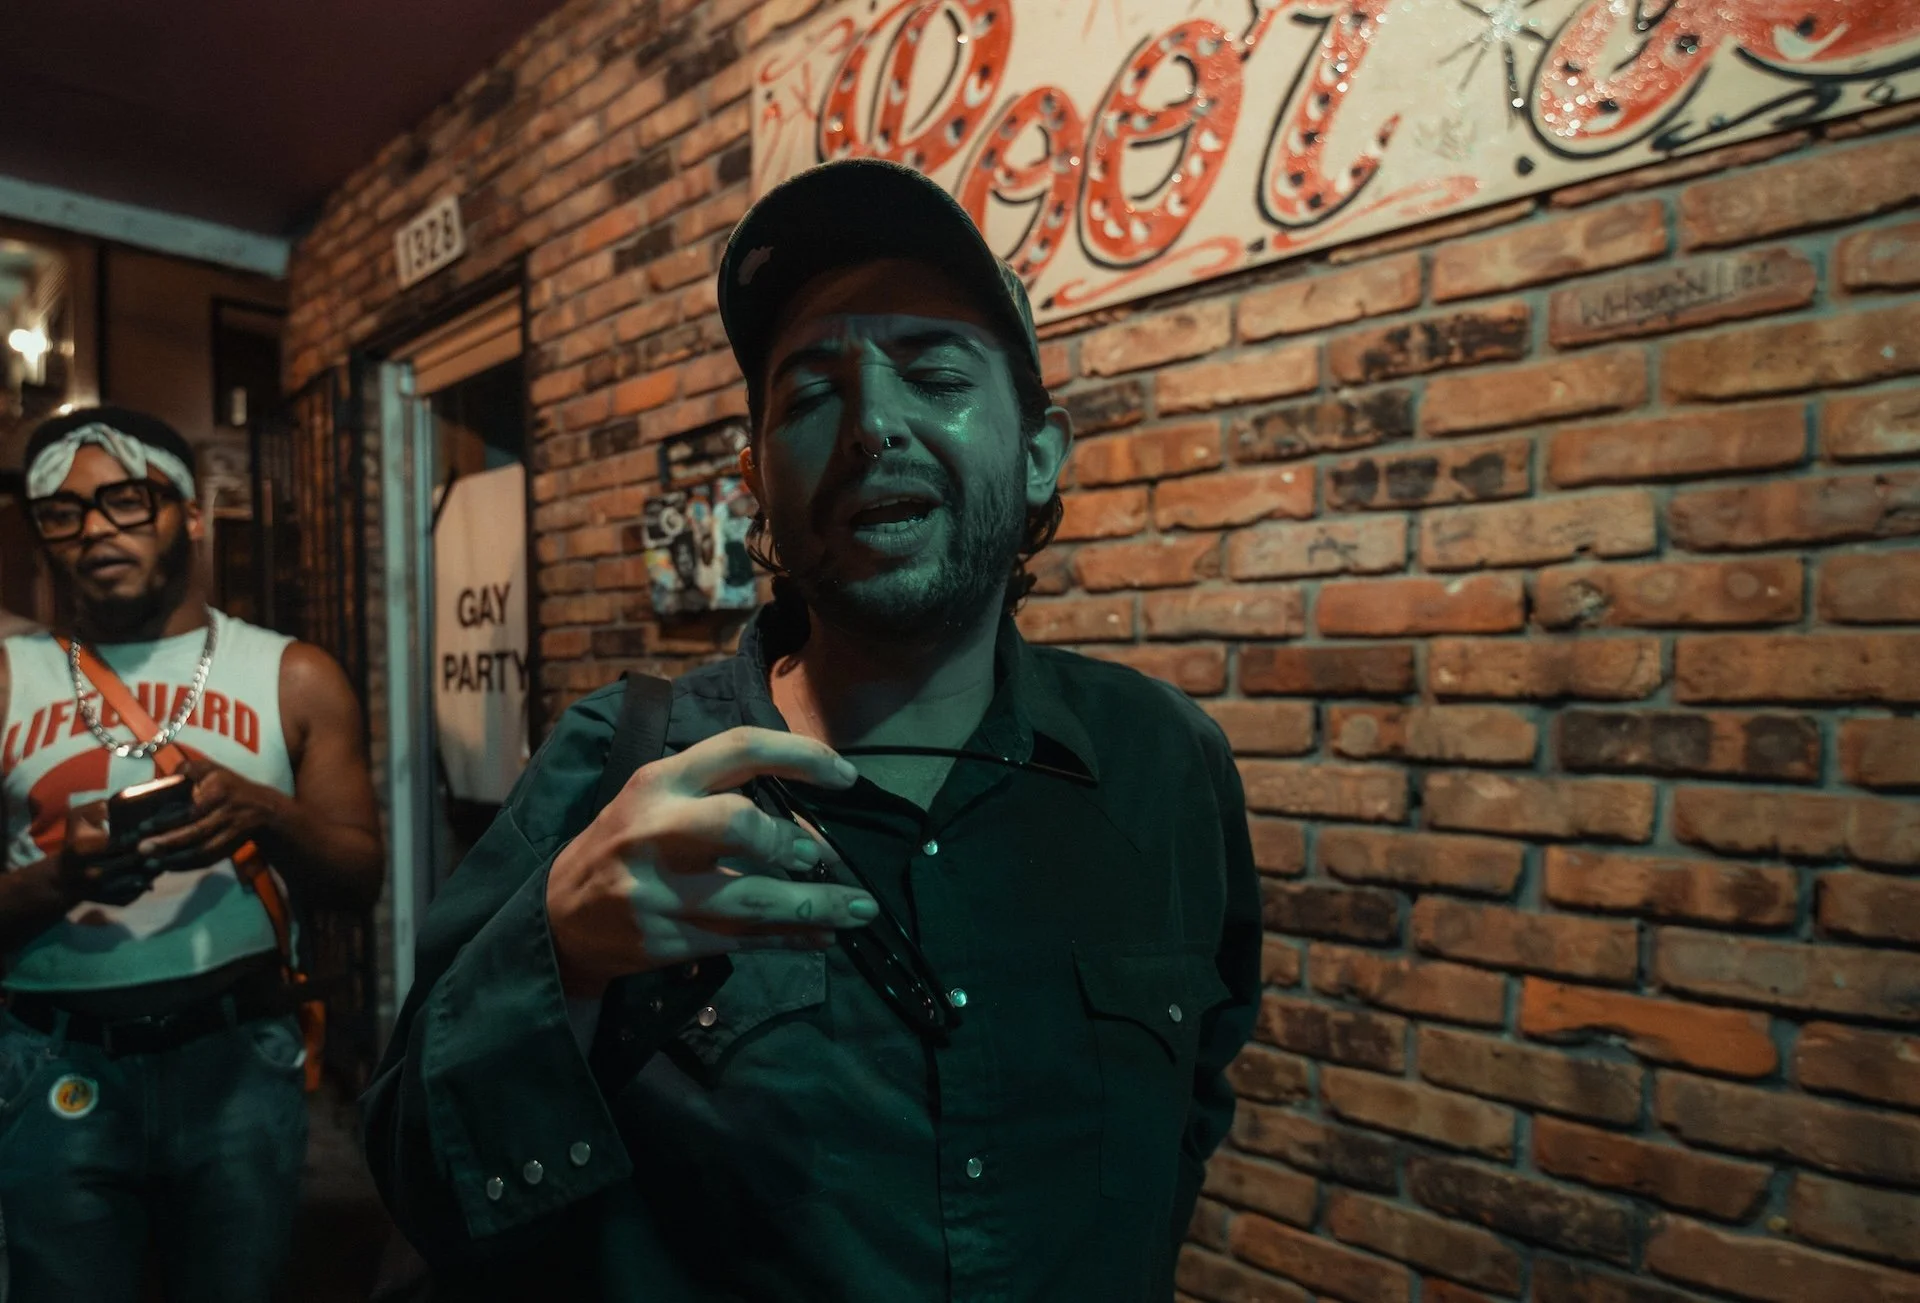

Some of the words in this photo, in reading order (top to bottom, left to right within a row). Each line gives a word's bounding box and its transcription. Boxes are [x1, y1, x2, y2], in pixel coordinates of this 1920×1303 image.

[404, 208, 455, 278] 1328
[457, 581, 511, 628] GAY
[443, 650, 529, 692] PARTY
